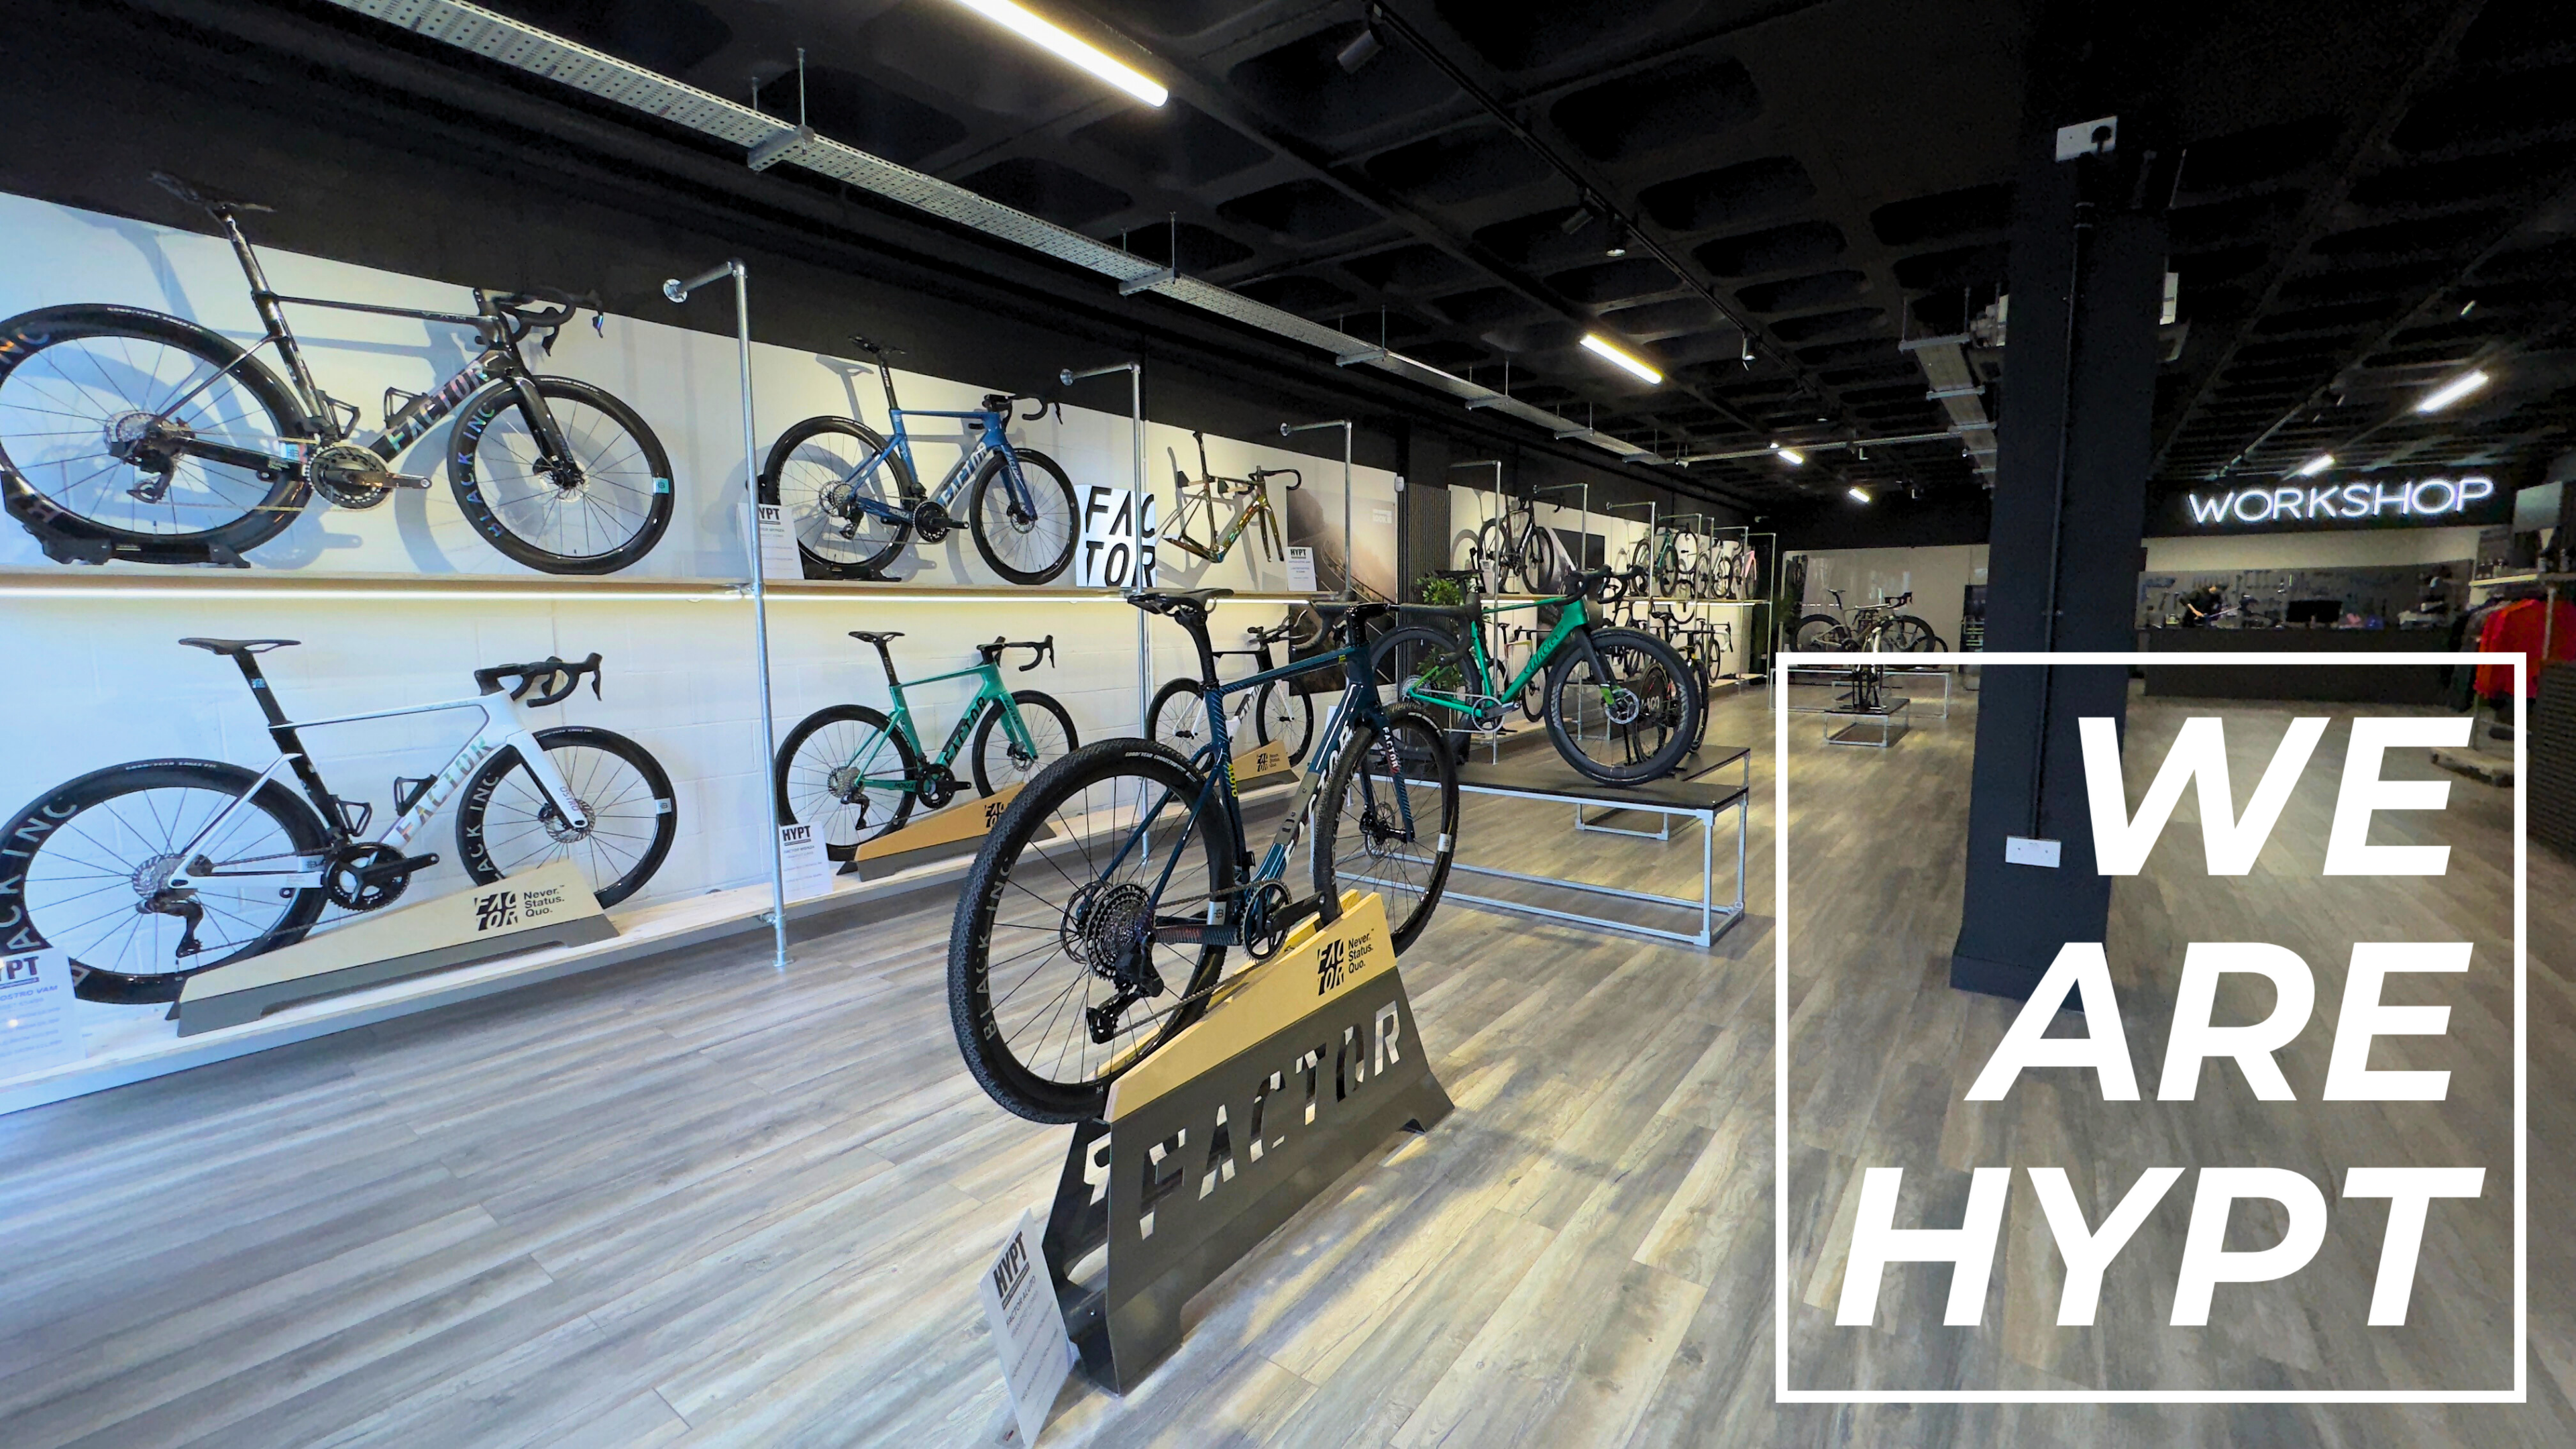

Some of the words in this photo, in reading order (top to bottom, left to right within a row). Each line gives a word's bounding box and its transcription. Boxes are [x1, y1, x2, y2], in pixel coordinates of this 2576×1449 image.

[386, 360, 490, 453] FACTOR
[463, 402, 495, 440] INC
[940, 441, 988, 507] FACTOR
[458, 452, 502, 537] BLACK
[759, 507, 780, 521] YPT
[1085, 486, 1155, 539] FAC
[2188, 478, 2493, 524] WORKSHOP
[1086, 540, 1156, 587] TOR
[943, 696, 986, 765] FACTOR
[1382, 726, 1400, 768] FACTOR
[396, 735, 494, 843] FACTOR
[470, 773, 499, 812] INC
[559, 786, 580, 812] OSTRO
[3, 805, 78, 857] INC
[782, 825, 811, 842] HYPT
[985, 814, 998, 828] TO
[474, 891, 517, 914] FAC
[525, 896, 565, 909] Status.
[986, 857, 1014, 912] INC
[476, 909, 519, 931] TOR
[525, 907, 553, 918] Quo.
[1318, 938, 1344, 974] FAC
[1348, 943, 1373, 962] Status.
[1348, 960, 1366, 974] Quo.
[37, 984, 58, 994] VAM
[976, 930, 998, 1040] BLACK
[1318, 965, 1344, 996] TOR
[1140, 1000, 1401, 1241] FACTOR
[993, 1230, 1027, 1299] HYPT
[1006, 1295, 1024, 1329] FACTOR
[1022, 1275, 1036, 1302] ALUTO
